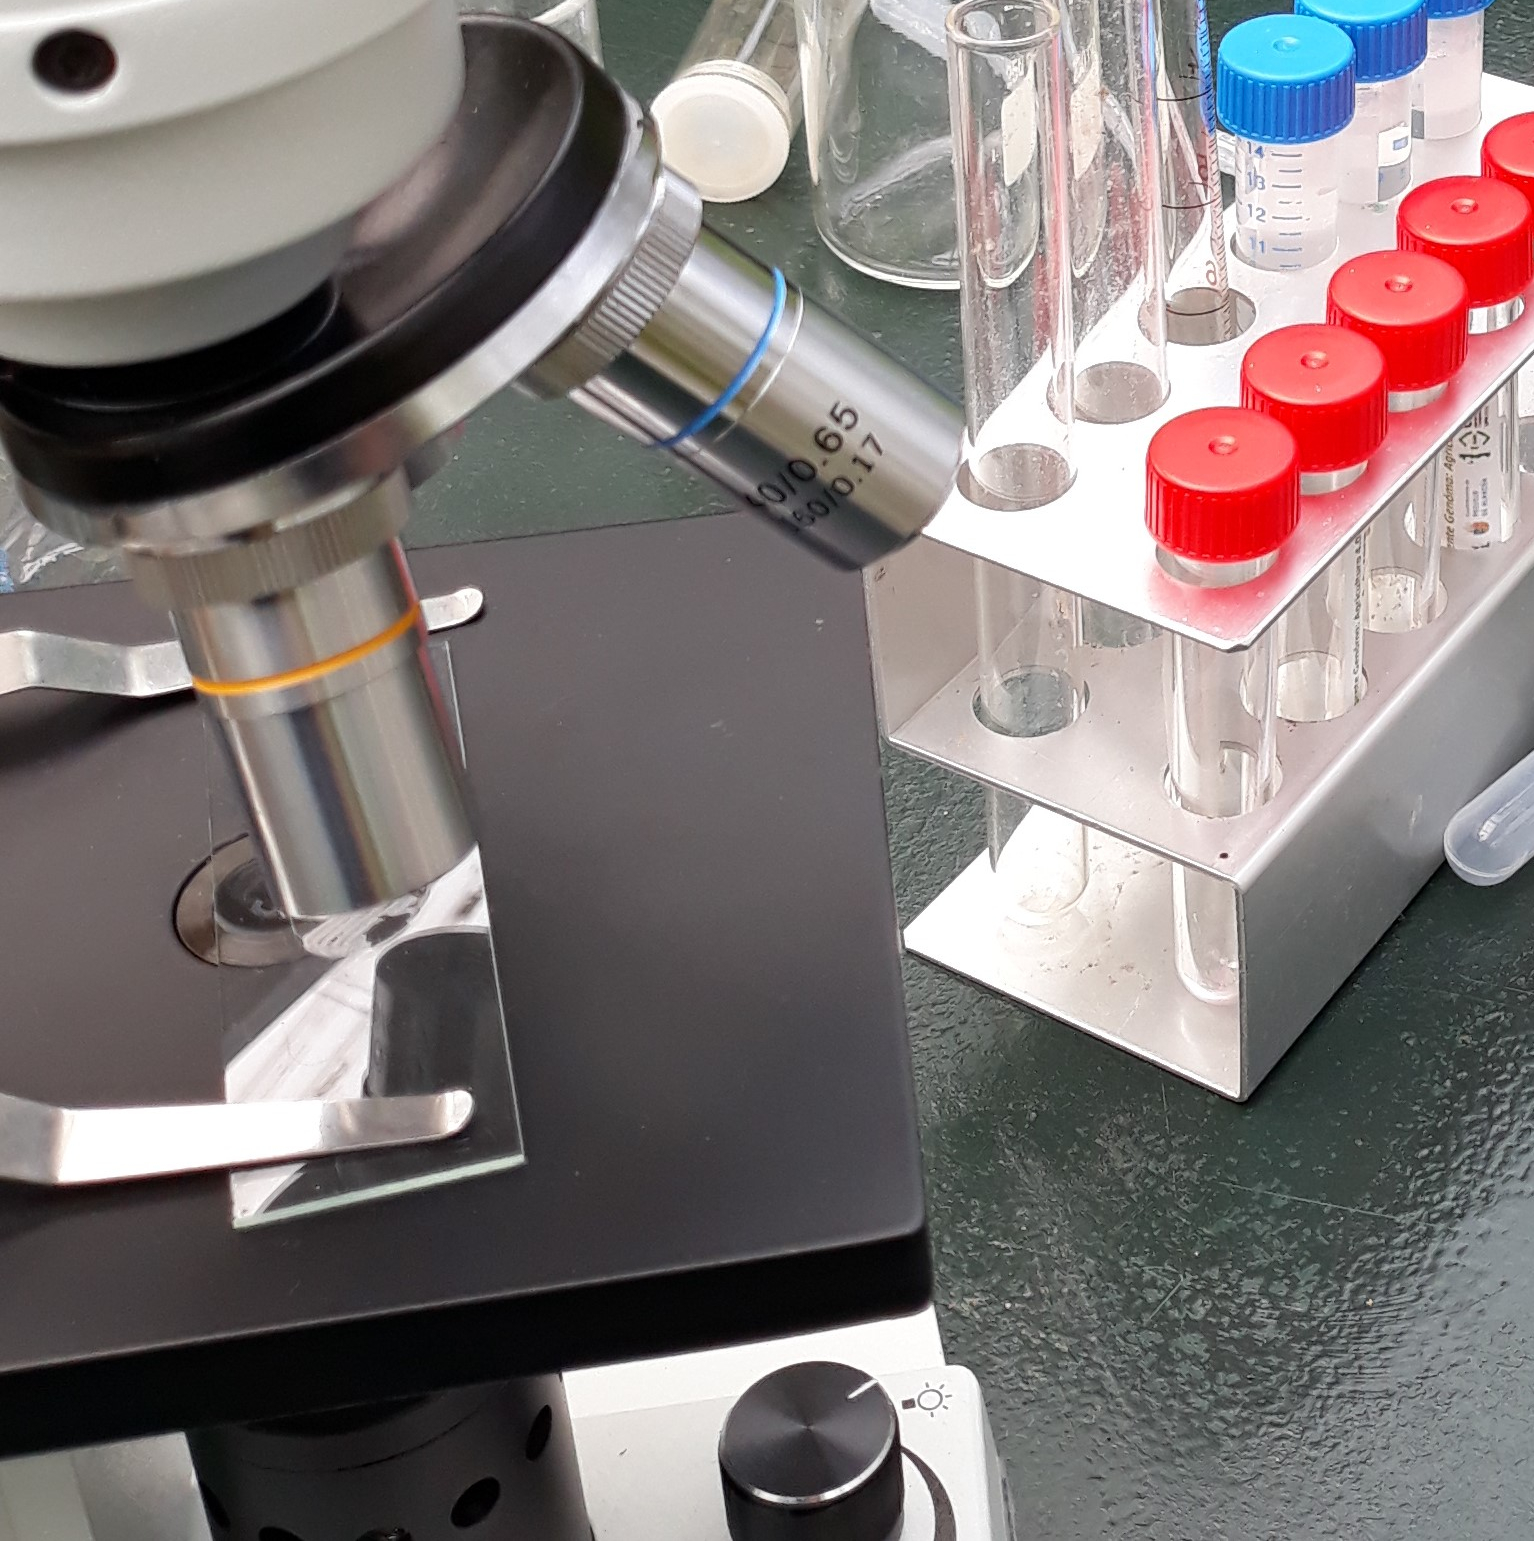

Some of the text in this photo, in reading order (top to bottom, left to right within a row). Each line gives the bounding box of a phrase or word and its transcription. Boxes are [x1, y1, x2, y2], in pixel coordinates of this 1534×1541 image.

[1247, 141, 1265, 159] 14
[1247, 171, 1266, 191] 13
[1248, 204, 1266, 223] 12
[1249, 236, 1266, 254] 11
[746, 401, 859, 507] 0/0.65
